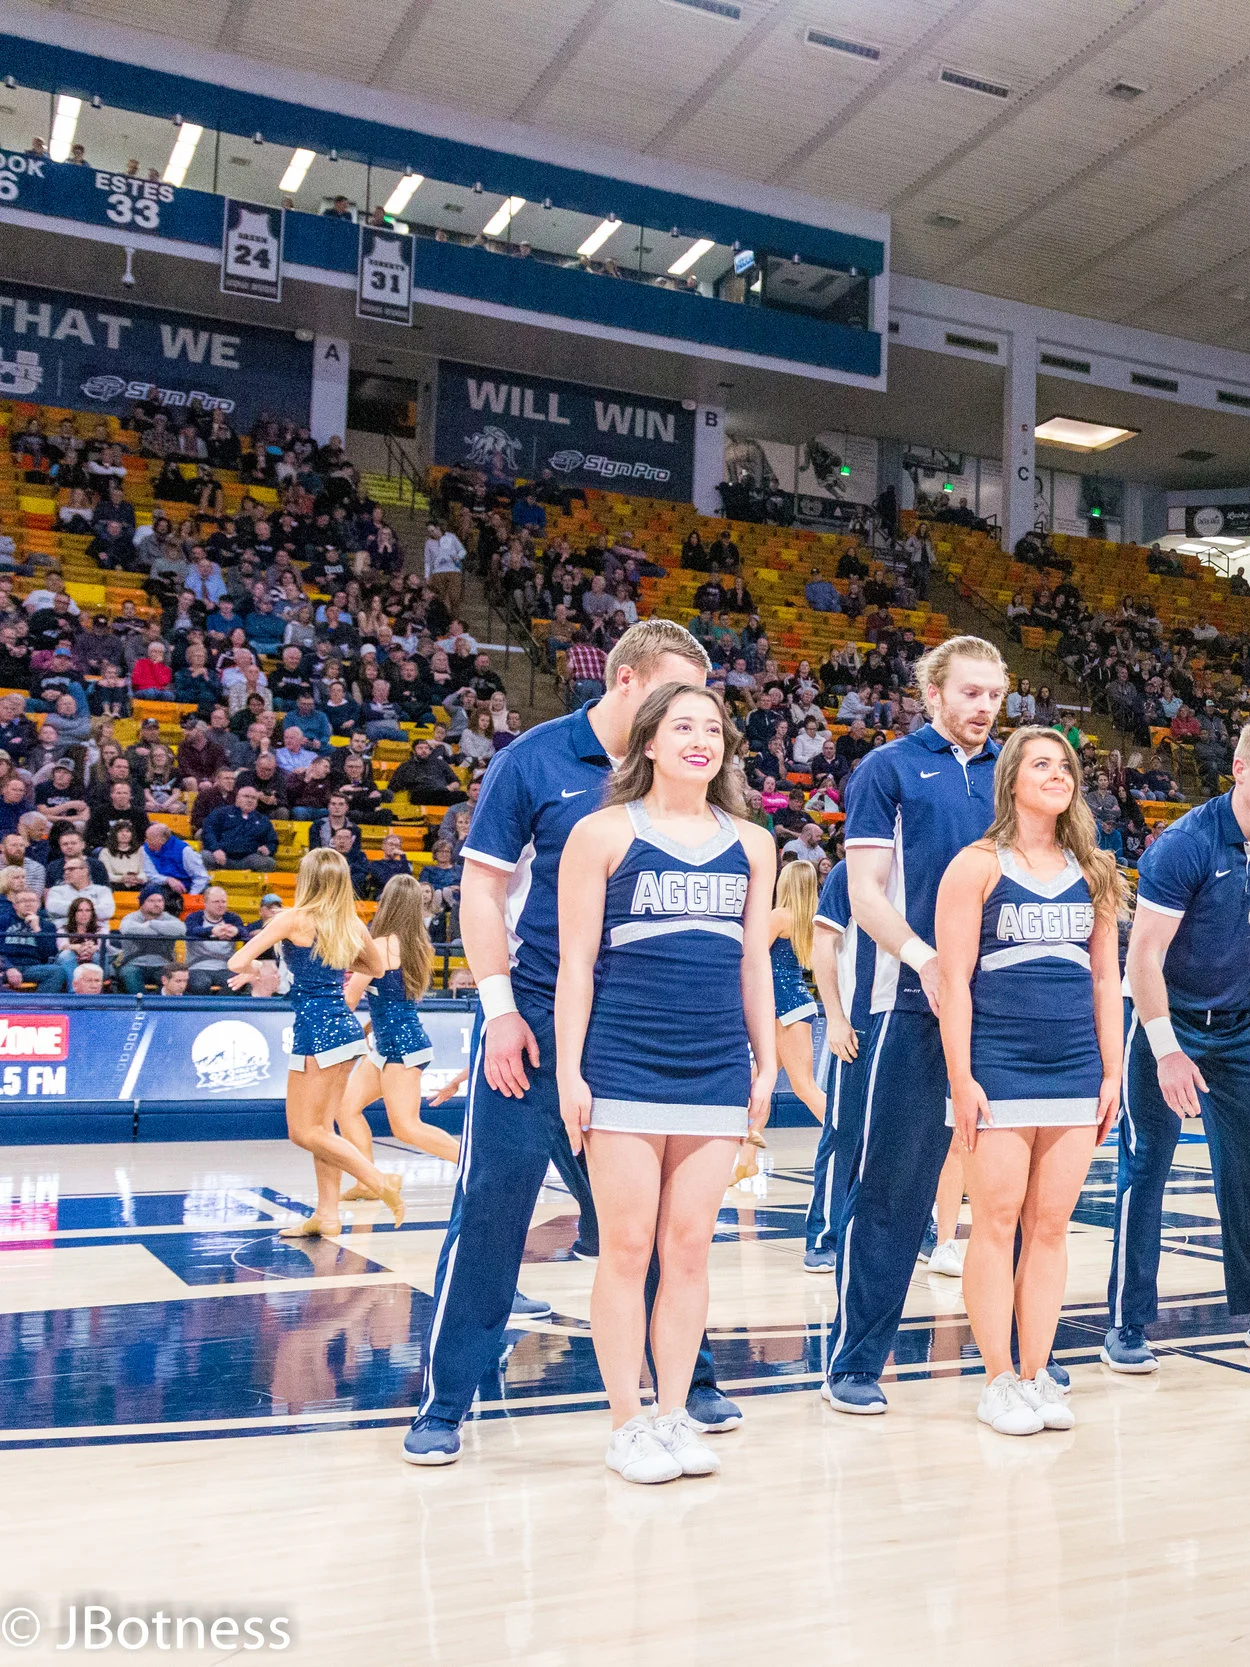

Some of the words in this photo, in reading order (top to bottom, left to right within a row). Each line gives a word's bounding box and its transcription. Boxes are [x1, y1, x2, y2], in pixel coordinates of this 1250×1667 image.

[95, 172, 174, 203] ESTES
[106, 194, 160, 229] 33
[233, 244, 271, 269] 24
[370, 270, 401, 293] 31
[159, 323, 241, 370] WE
[324, 343, 341, 363] A
[466, 378, 570, 426] WILL
[594, 400, 676, 443] WIN
[705, 411, 719, 427] B
[583, 454, 632, 479] Sign
[631, 462, 672, 484] Pro
[1017, 466, 1029, 482] C
[630, 870, 748, 917] AGGIES
[996, 901, 1095, 943] AGGIES
[27, 1066, 67, 1095] FM
